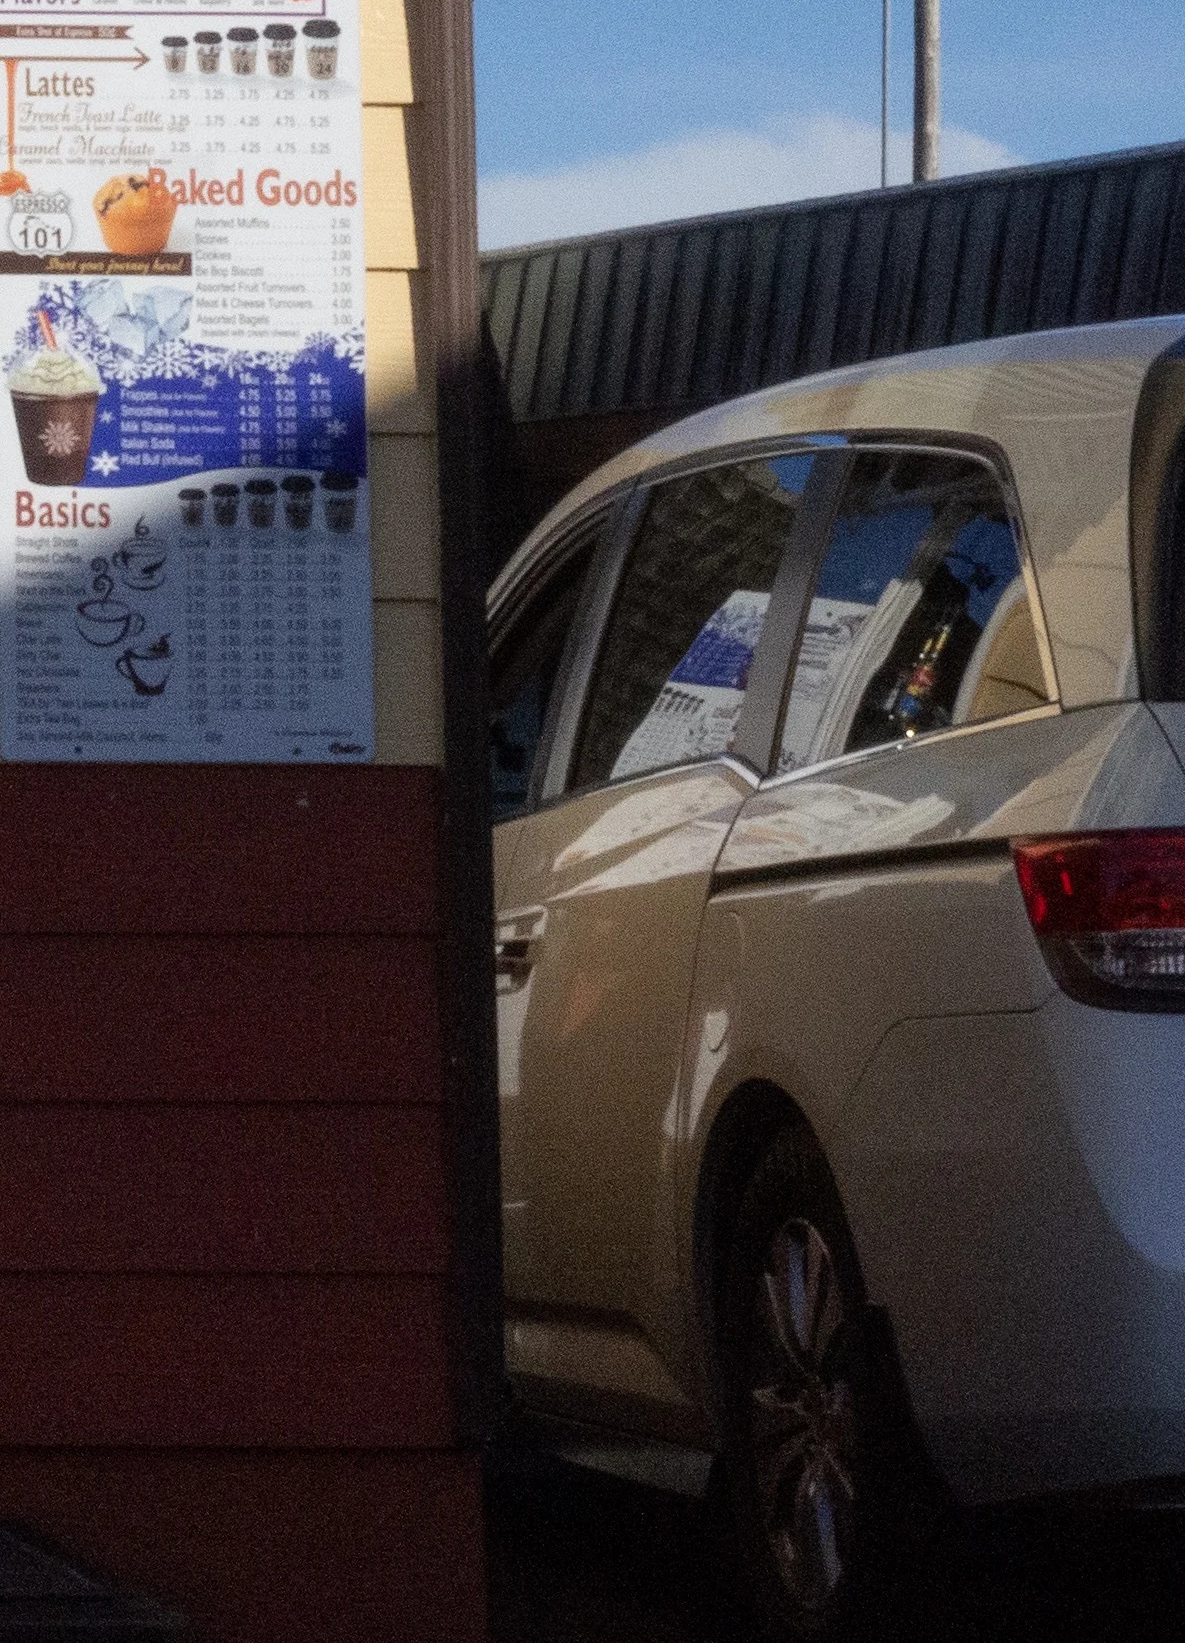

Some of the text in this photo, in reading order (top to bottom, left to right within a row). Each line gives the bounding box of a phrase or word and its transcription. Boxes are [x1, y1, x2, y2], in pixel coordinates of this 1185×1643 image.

[25, 67, 95, 98] Lattes
[18, 101, 162, 124] French Toast Latte
[68, 134, 155, 156] Macchiato
[148, 167, 358, 208] Baked Goods
[14, 198, 65, 214] ESPRESSO
[18, 227, 63, 250] 101
[15, 489, 112, 529] Basics
